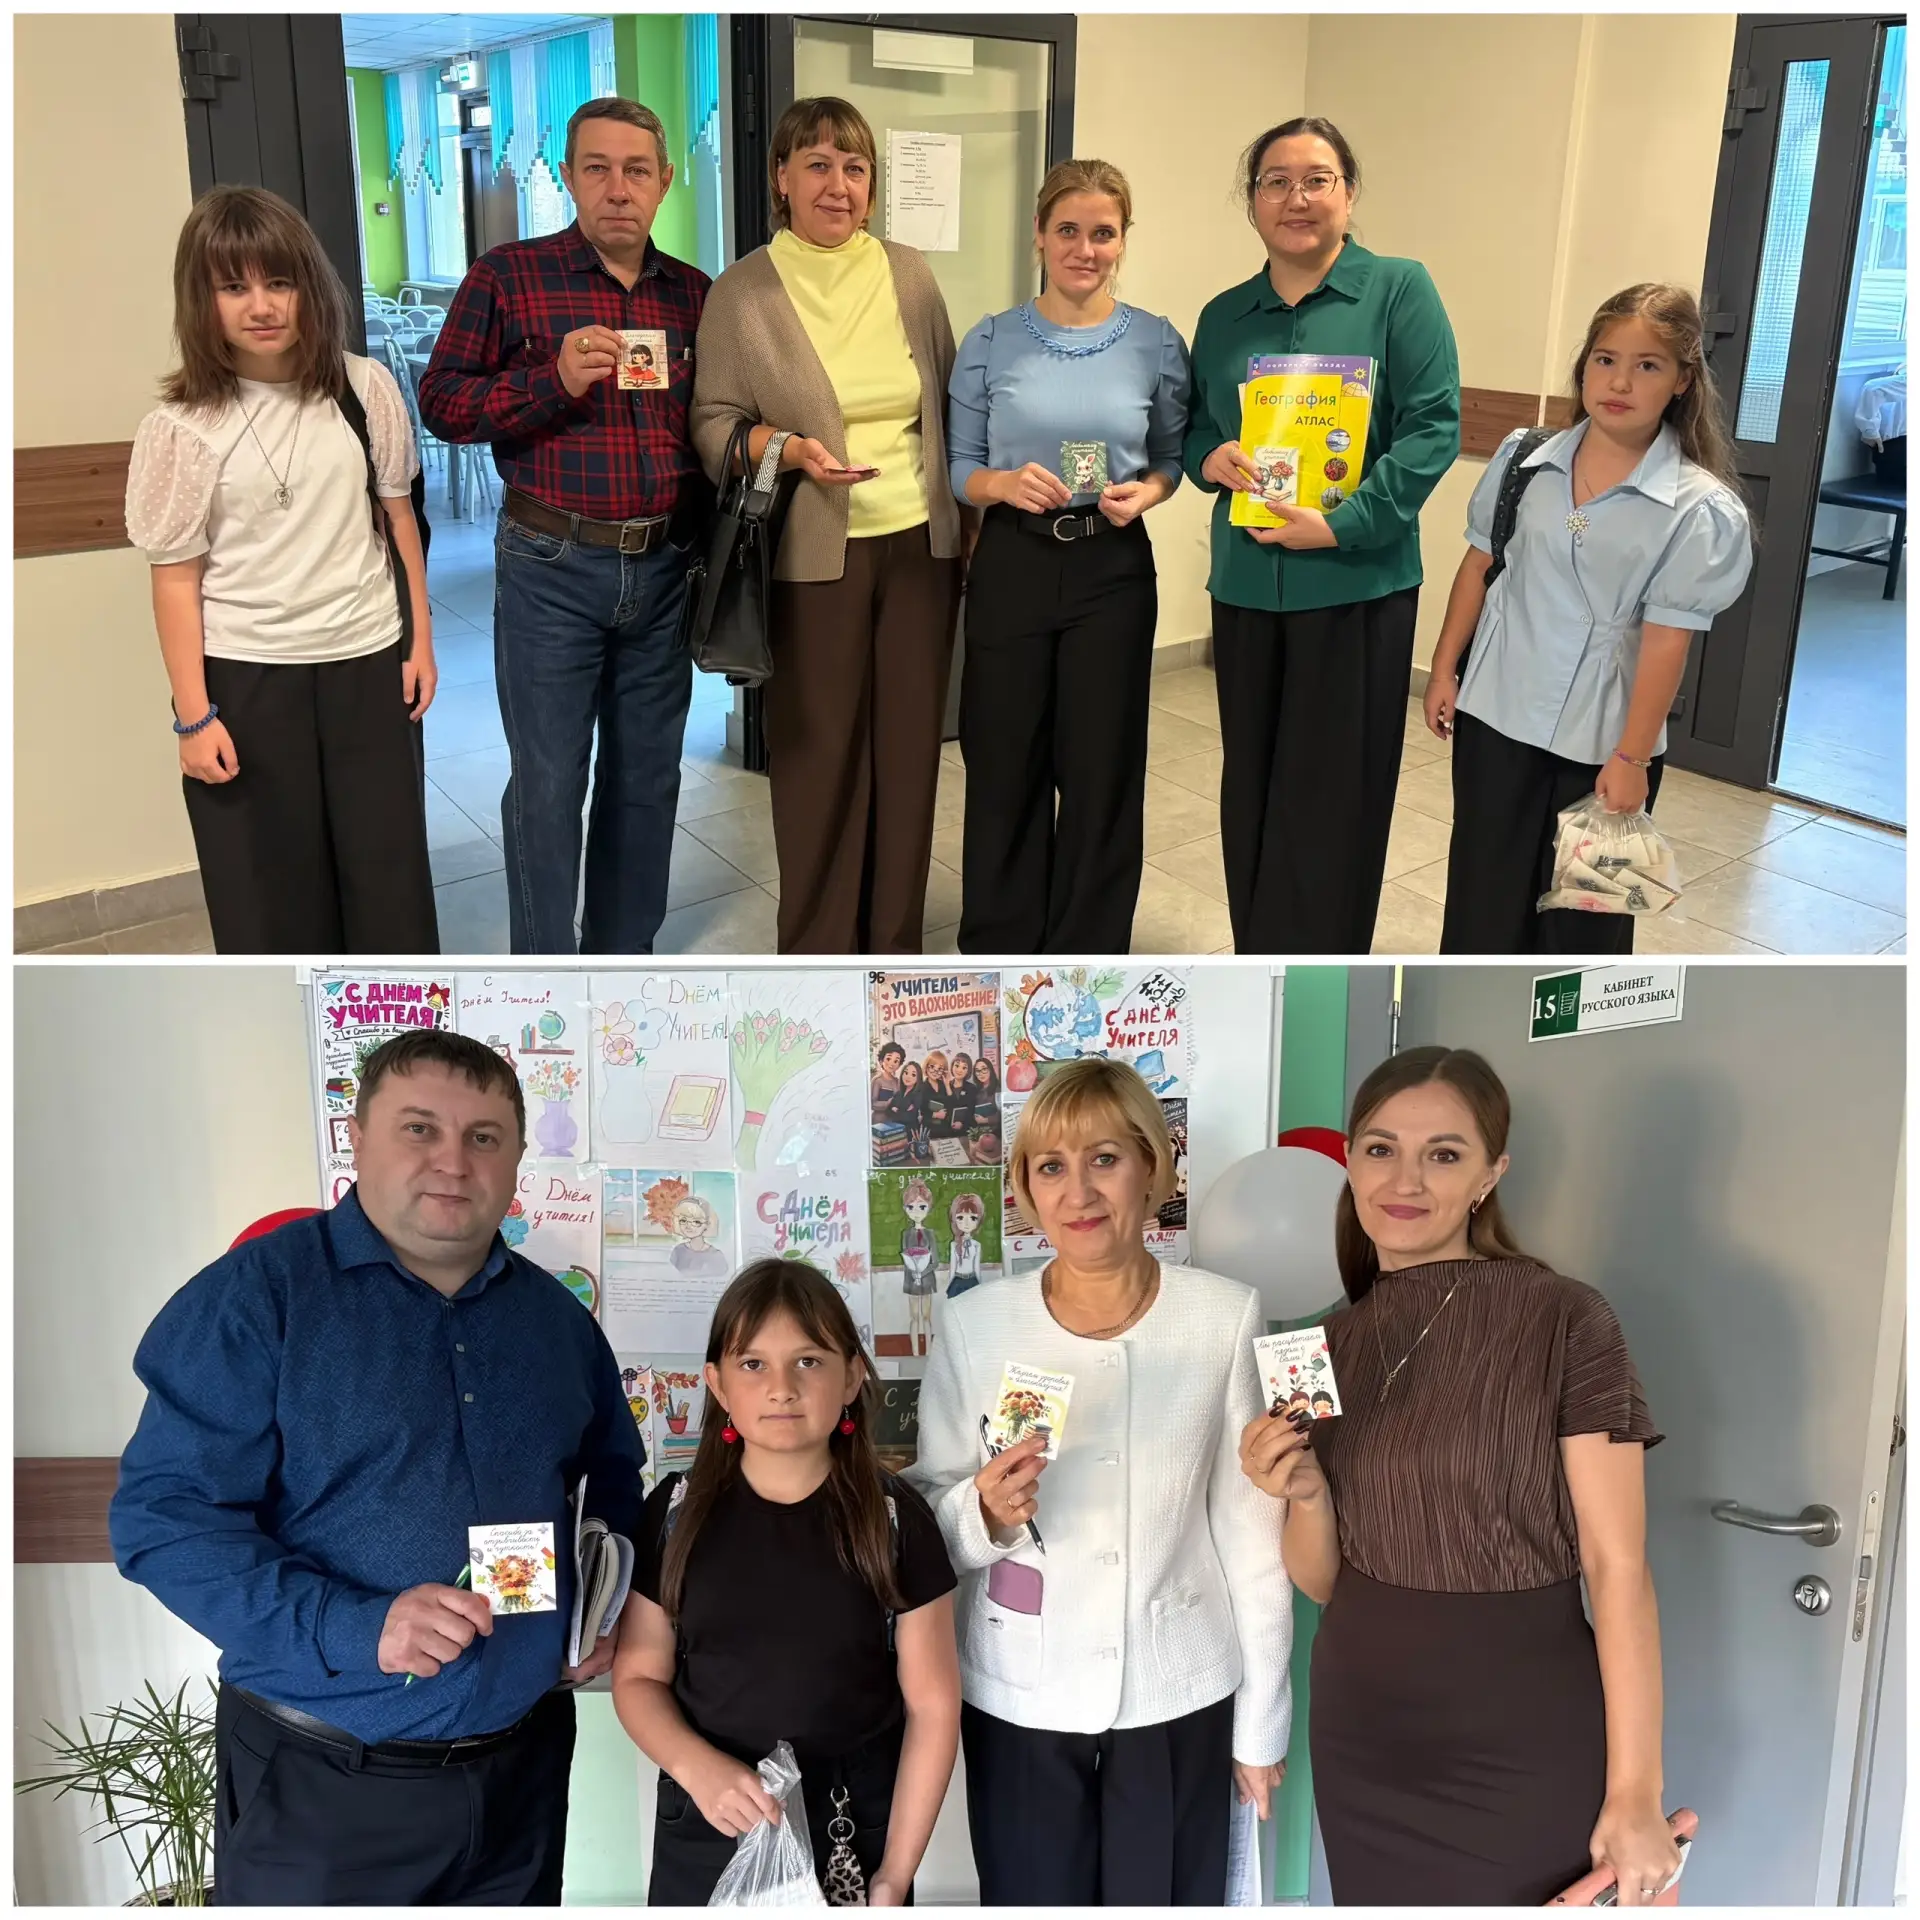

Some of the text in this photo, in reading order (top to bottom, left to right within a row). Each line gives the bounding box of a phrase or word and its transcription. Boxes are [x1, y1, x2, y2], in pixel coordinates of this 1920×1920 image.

[1255, 391, 1336, 409] География
[1295, 416, 1335, 426] АТЛАС
[484, 976, 493, 987] С
[641, 977, 655, 999] С
[890, 976, 958, 999] УЧИТЕЛЯ
[1603, 975, 1654, 994] КАБИНЕТ
[345, 982, 422, 1004] С ДНЁМ
[501, 990, 551, 1004] Учителя!
[1581, 988, 1675, 1014] РУССКОГО ЯЗЫКА
[882, 989, 998, 1021] ЭТО ВДОХНОВЕНИЕ!
[1533, 994, 1556, 1020] 15
[326, 1004, 443, 1030] УЧИТЕЛЯ!
[1105, 1007, 1121, 1026] С
[520, 1172, 592, 1202] С Днём
[756, 1191, 779, 1224] С
[532, 1209, 595, 1230] учителя!
[774, 1220, 851, 1251] учителя
[1272, 1334, 1321, 1351] расцветаем
[484, 1535, 541, 1548] отзывчивость
[490, 1526, 533, 1538] Спасибо за
